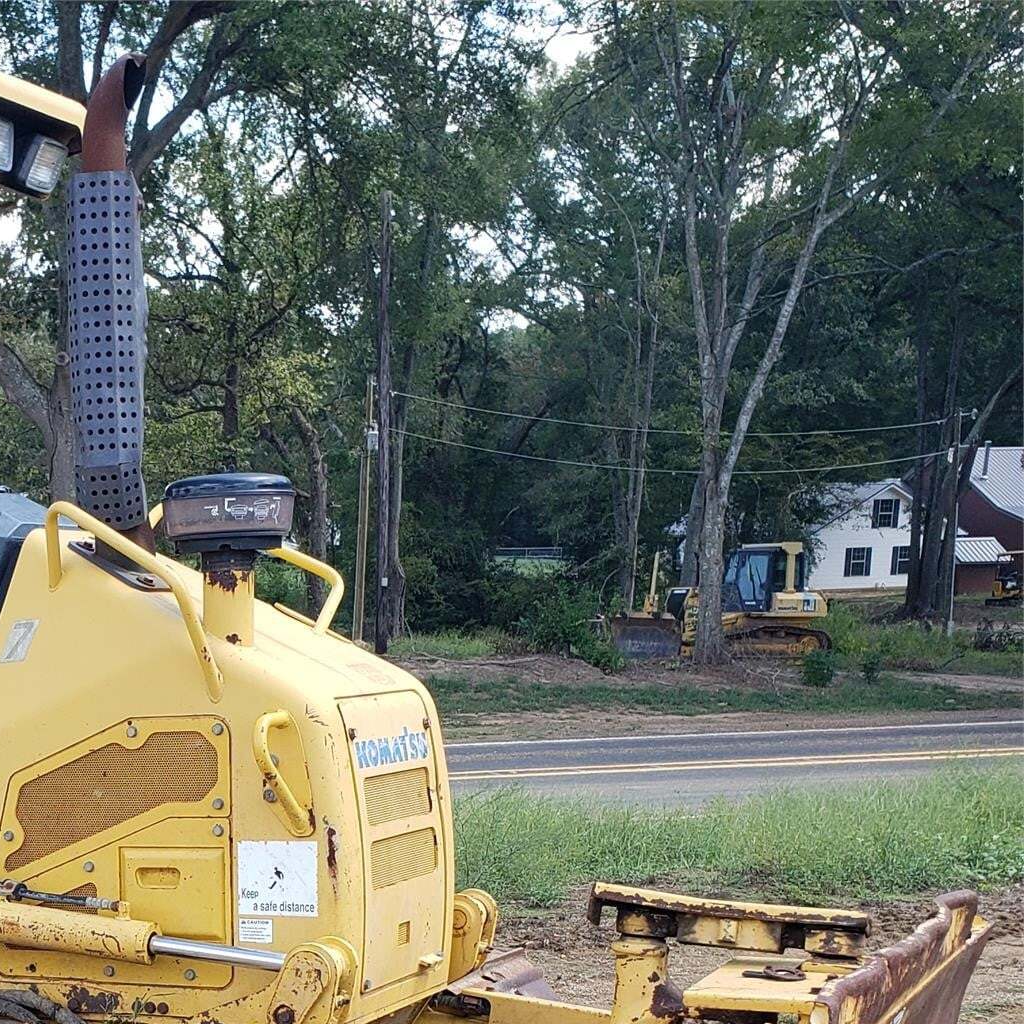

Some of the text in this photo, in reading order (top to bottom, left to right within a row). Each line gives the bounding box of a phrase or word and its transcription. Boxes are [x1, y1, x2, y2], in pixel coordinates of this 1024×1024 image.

[355, 725, 429, 769] KOMATSU
[241, 887, 259, 900] Keep
[253, 900, 315, 913] a safe distance
